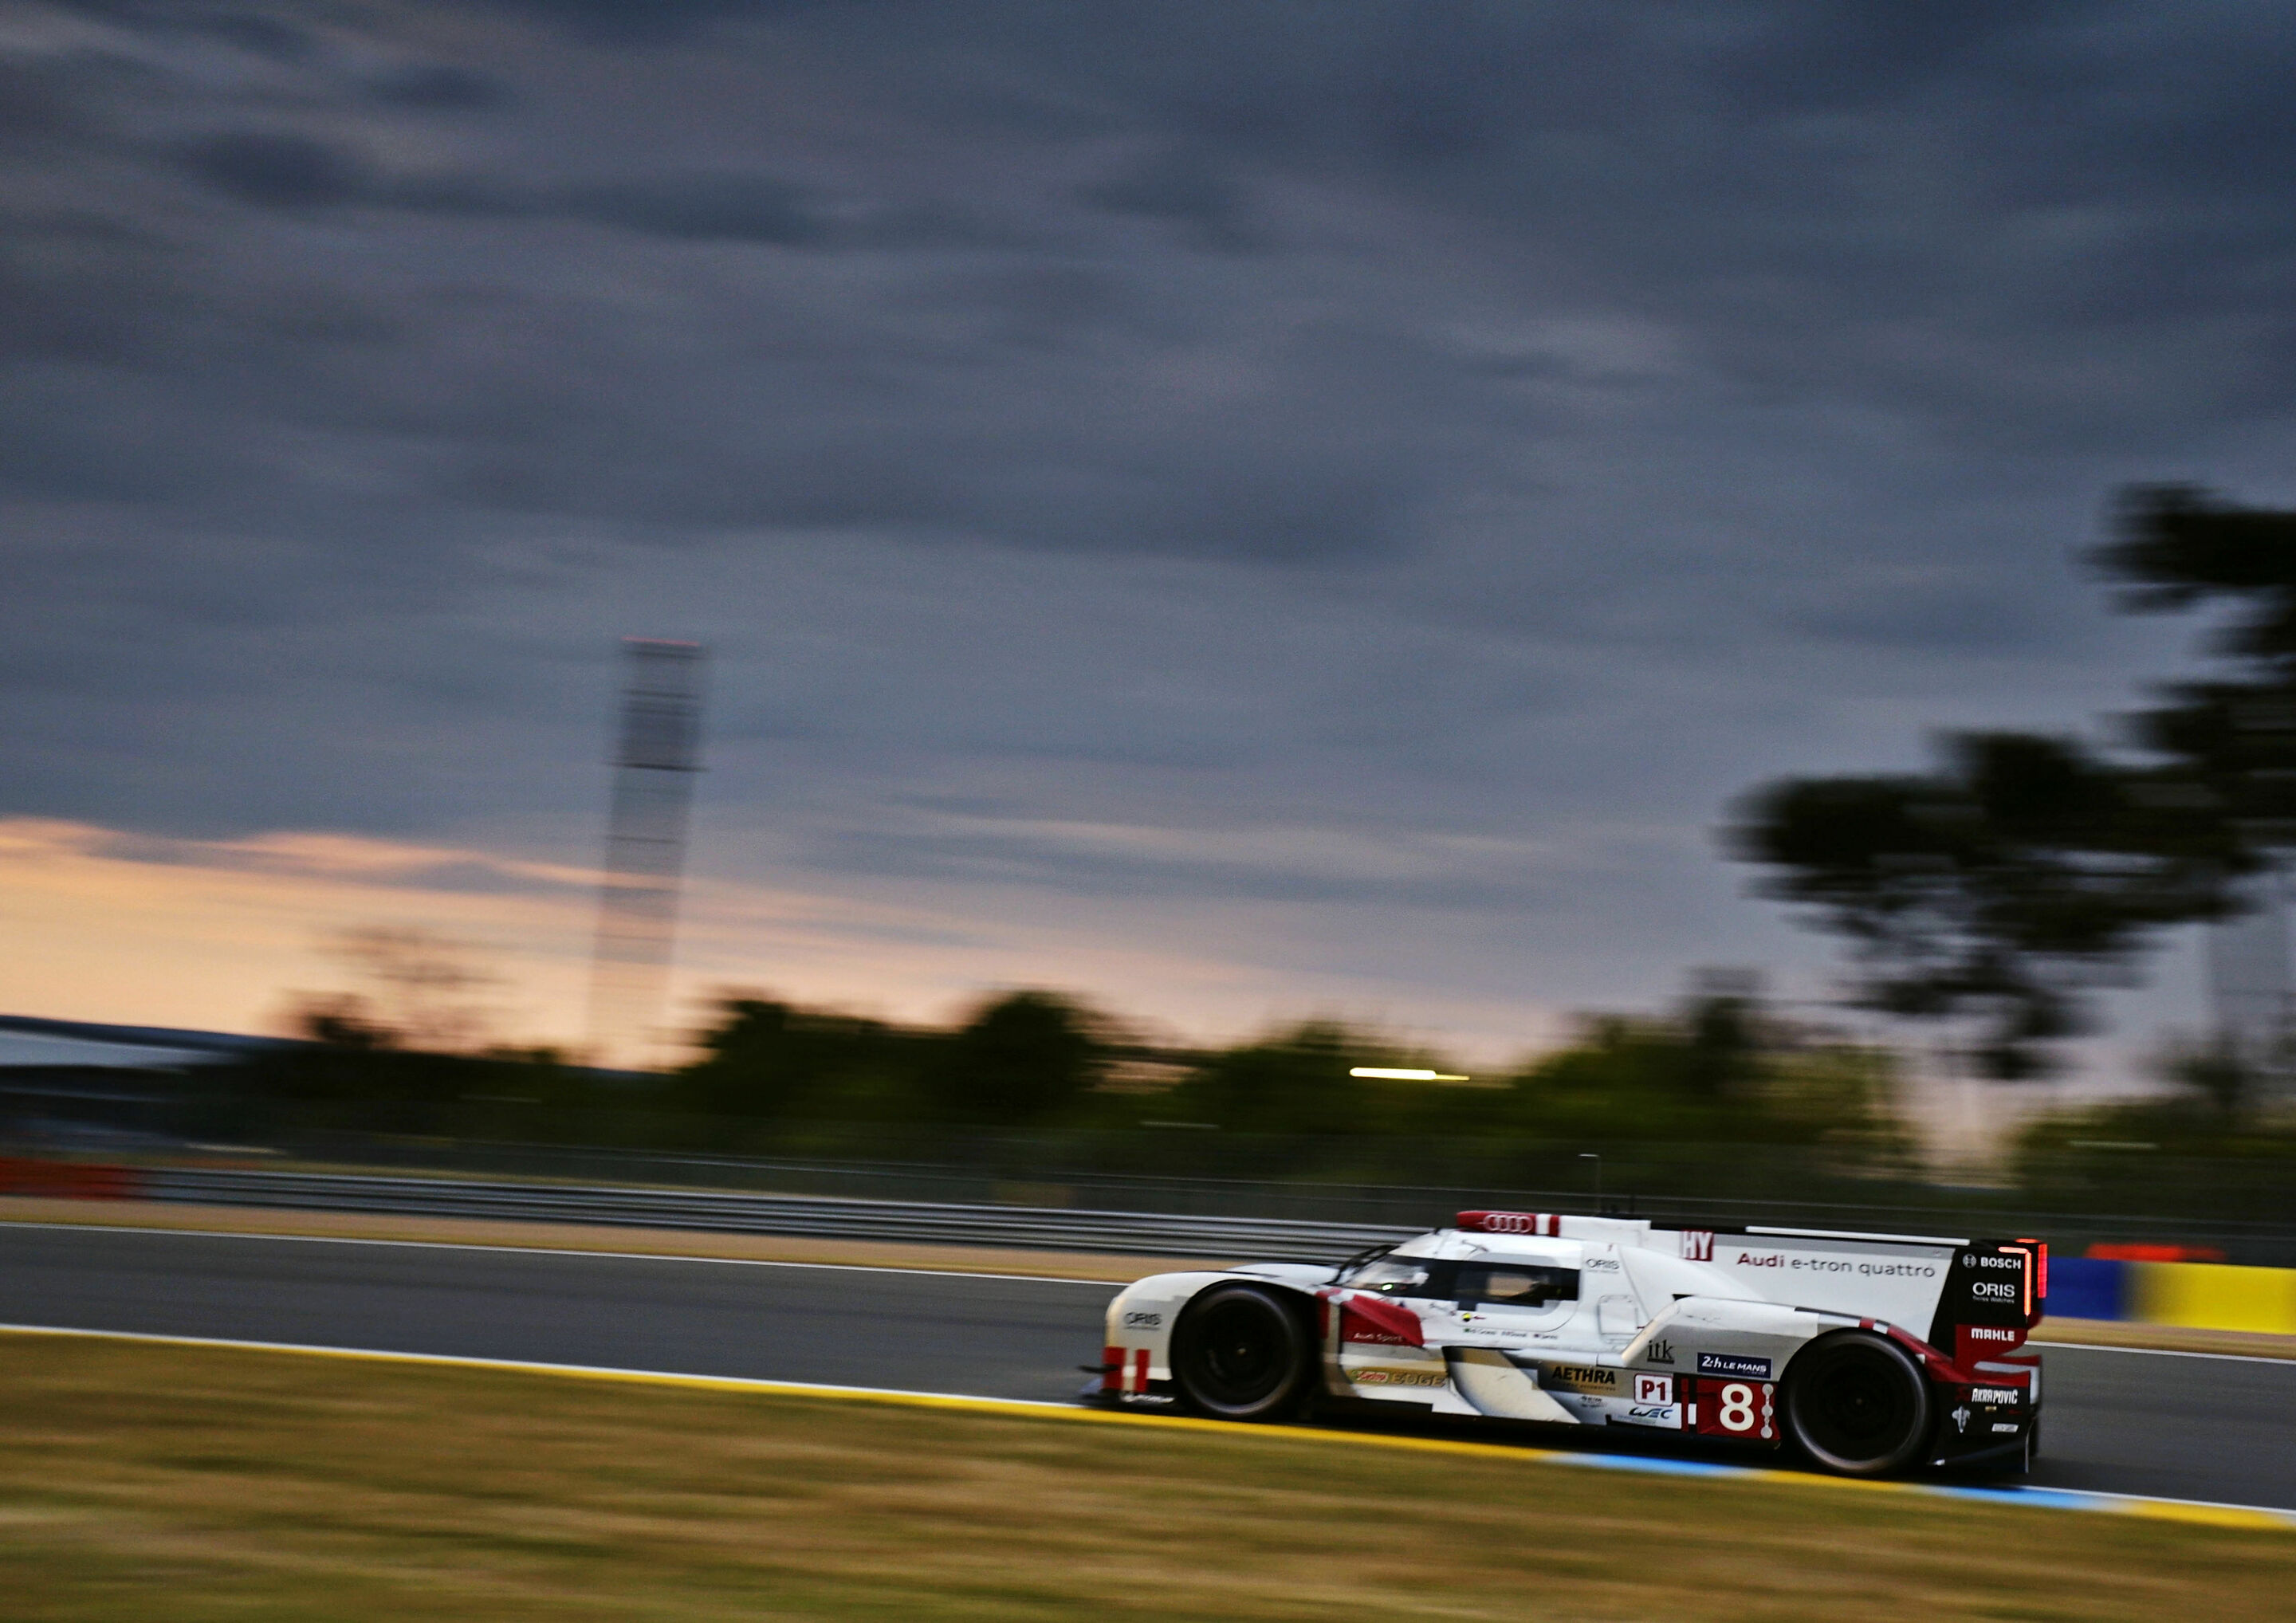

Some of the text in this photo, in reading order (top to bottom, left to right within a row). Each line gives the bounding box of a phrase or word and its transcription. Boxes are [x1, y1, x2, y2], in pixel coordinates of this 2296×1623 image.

[1586, 1259, 1620, 1270] ORIS
[1736, 1252, 1936, 1278] Audi e-tron quattro
[1980, 1256, 2022, 1270] BOSCH
[1972, 1281, 2015, 1298] ORIS
[1971, 1328, 2015, 1342] MAHLE
[1647, 1338, 1674, 1360] itk
[1551, 1366, 1616, 1385] AETHRA
[1723, 1362, 1736, 1370] LE
[1736, 1363, 1767, 1373] MANS
[1390, 1373, 1446, 1388] EDGE
[1641, 1379, 1666, 1401] P1
[1628, 1406, 1674, 1420] WEC
[1719, 1383, 1755, 1432] 8
